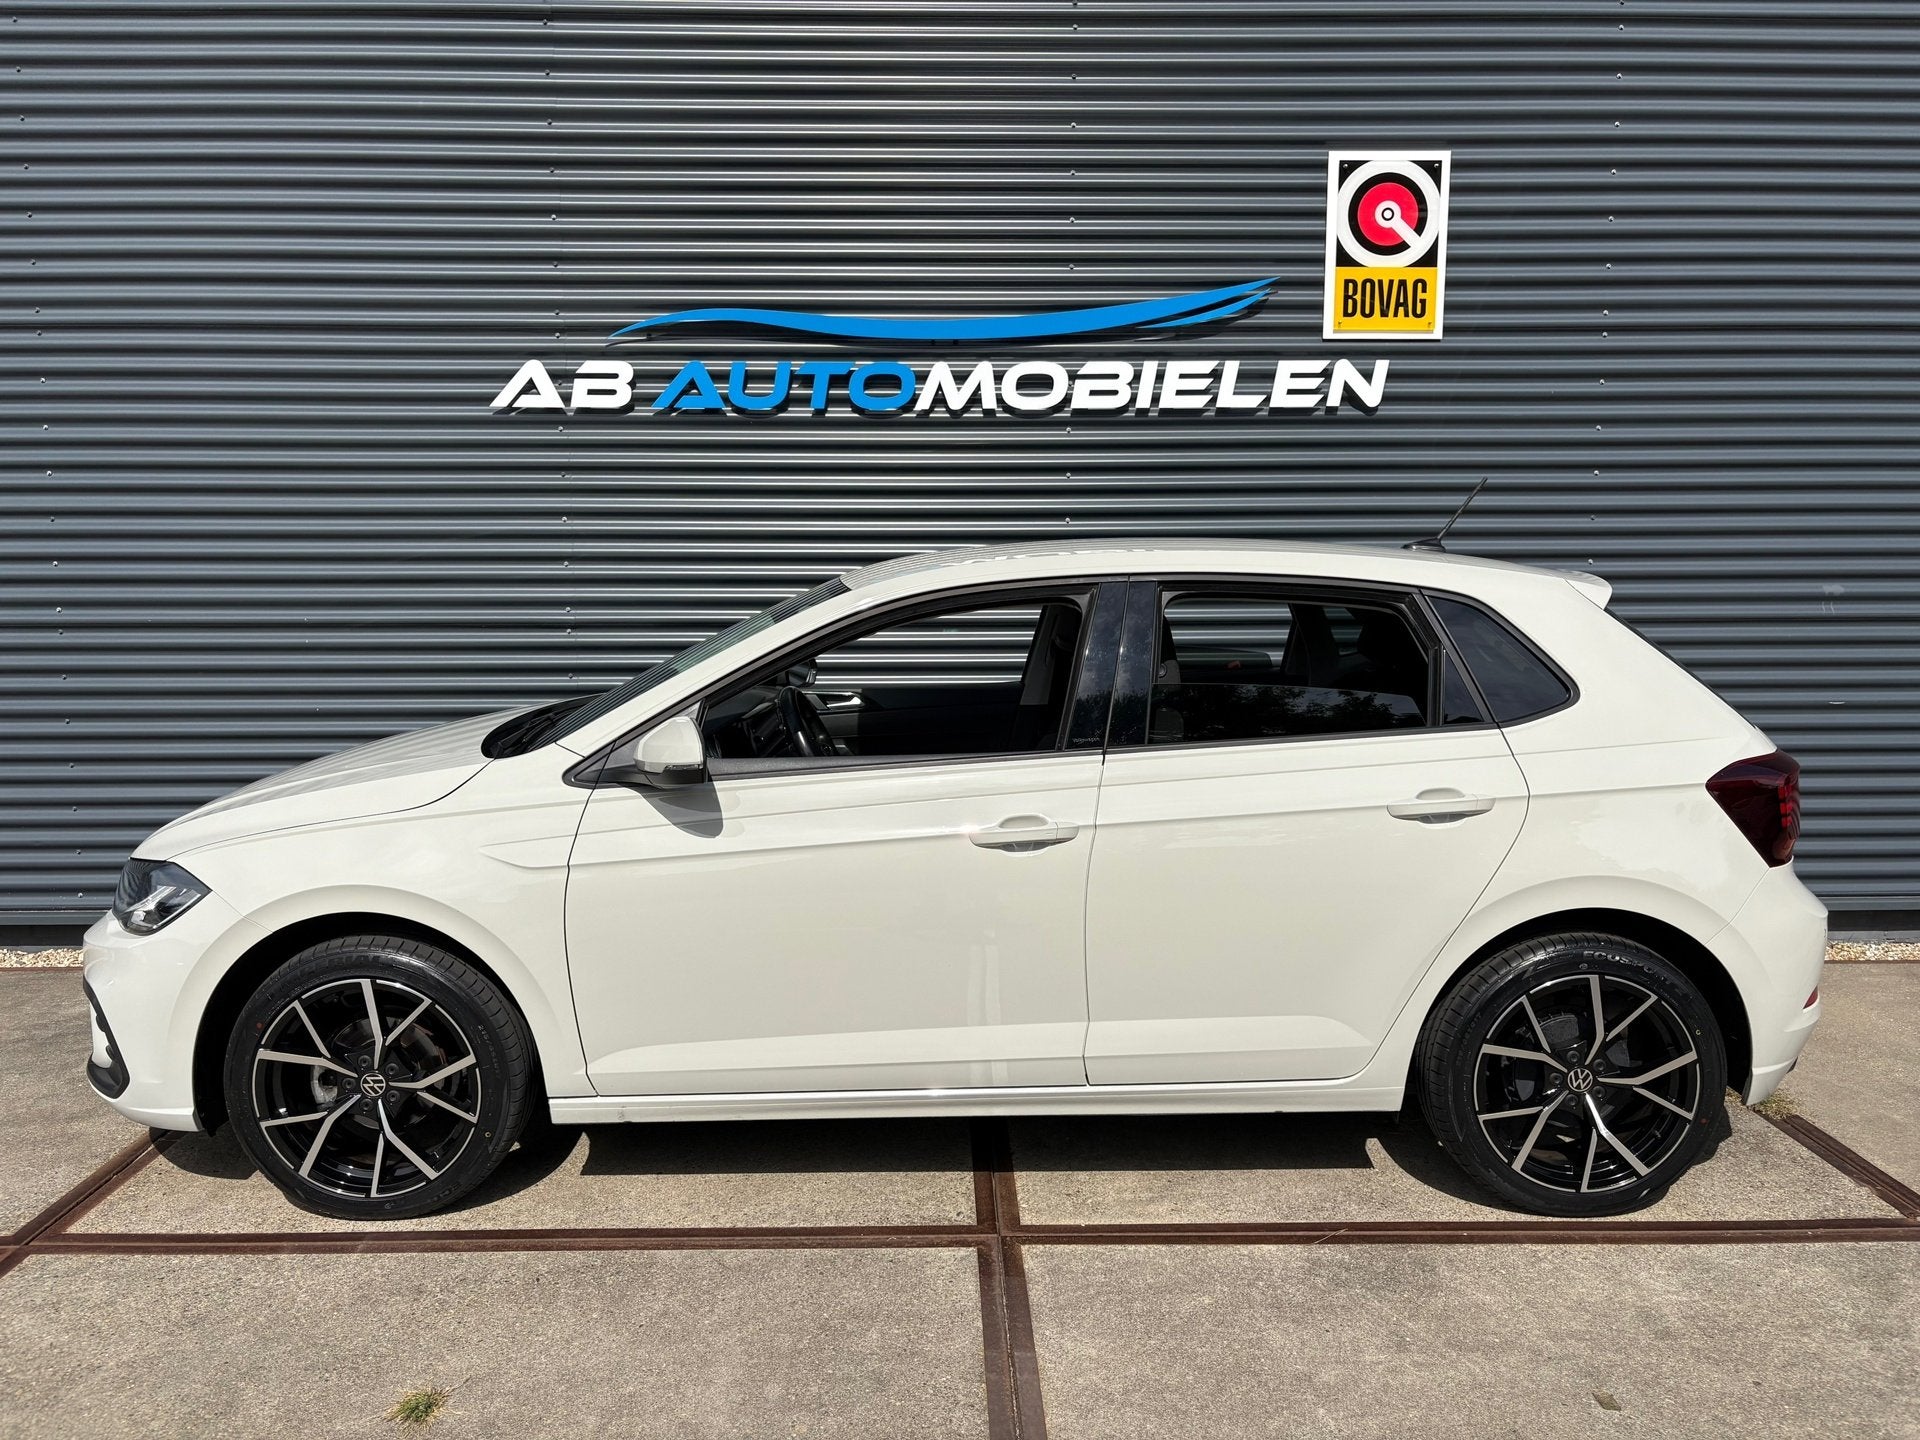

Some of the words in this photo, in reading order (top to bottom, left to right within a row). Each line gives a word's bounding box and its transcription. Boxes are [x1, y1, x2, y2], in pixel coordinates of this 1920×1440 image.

[1343, 278, 1427, 318] BOVAG
[489, 359, 635, 408] AB
[651, 359, 1390, 411] AUTOMOBIELEN
